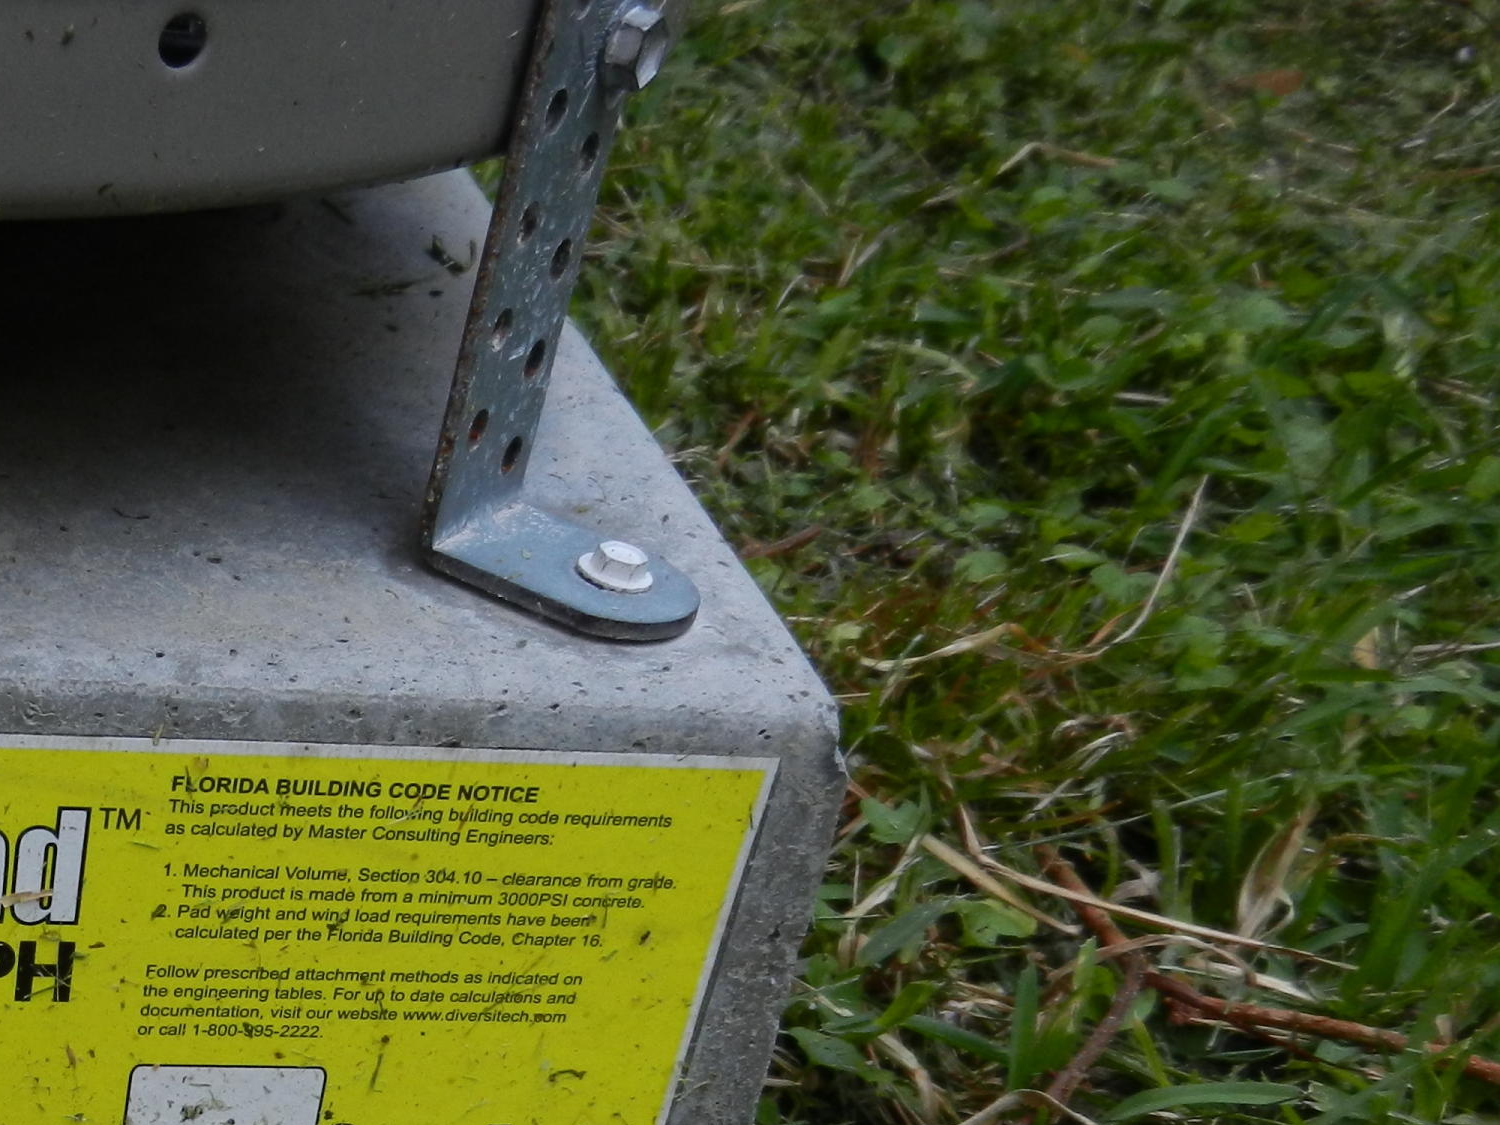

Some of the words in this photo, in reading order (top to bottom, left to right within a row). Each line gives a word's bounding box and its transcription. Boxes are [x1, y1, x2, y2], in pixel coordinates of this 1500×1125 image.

[171, 776, 269, 794] FLORIDA
[276, 778, 381, 798] BUILDING
[388, 782, 451, 800] CODE
[457, 784, 540, 803] NOTICE
[168, 799, 205, 814] This
[209, 801, 276, 818] product
[280, 803, 332, 818] meets
[338, 802, 364, 819] the
[369, 804, 443, 824] following
[448, 808, 513, 827] building
[518, 811, 559, 825] code
[564, 812, 672, 829] requirements
[164, 823, 185, 835] as
[190, 821, 277, 838] calculated
[282, 824, 304, 840] by
[308, 824, 367, 840] Master
[372, 826, 460, 846] Consulting
[465, 829, 554, 848] Engineers:
[163, 863, 177, 877] 1.
[183, 863, 279, 880] Mechanical
[285, 866, 352, 883] Volume,
[358, 868, 420, 883] Section
[424, 868, 482, 885] 304.10
[501, 872, 581, 888] clearance
[587, 874, 623, 889] from
[627, 875, 677, 892] grade.
[181, 884, 217, 898] This
[221, 885, 285, 902] product
[290, 887, 304, 900] is
[308, 887, 356, 902] made
[361, 888, 398, 903] from
[402, 892, 413, 904] a
[418, 891, 493, 905] minimum
[497, 892, 569, 907] 3000PSI
[572, 894, 645, 909] concrete.
[155, 903, 171, 918] 2.
[177, 904, 211, 919] Pad
[216, 905, 271, 923] weight
[275, 906, 307, 920] and
[312, 907, 350, 922] wind
[355, 908, 390, 922] load
[395, 911, 501, 927] requirements
[506, 912, 545, 927] have
[550, 913, 590, 927] been
[175, 925, 259, 940] calculated
[263, 929, 292, 943] per
[296, 927, 321, 941] the
[327, 928, 383, 943] Florida
[388, 930, 452, 947] Building
[458, 930, 505, 947] Code,
[512, 932, 576, 949] Chapter
[582, 933, 603, 948] 16.
[145, 964, 199, 979] Follow
[204, 966, 290, 982] prescribed
[295, 968, 385, 983] attachment
[390, 970, 459, 984] methods
[464, 973, 483, 985] as
[487, 971, 559, 986] indicated
[563, 975, 583, 986] on
[143, 985, 168, 998] the
[173, 985, 269, 1002] engineering
[275, 987, 327, 1001] tables.
[333, 988, 360, 1001] For
[365, 991, 385, 1005] up
[390, 989, 405, 1003] to
[410, 989, 445, 1003] date
[450, 990, 541, 1004] calculations
[546, 992, 577, 1005] and
[140, 1004, 264, 1020] documentation,
[271, 1005, 301, 1019] visit
[306, 1008, 332, 1019] our
[337, 1007, 398, 1021] website
[137, 1025, 152, 1036] or
[159, 1023, 186, 1036] call
